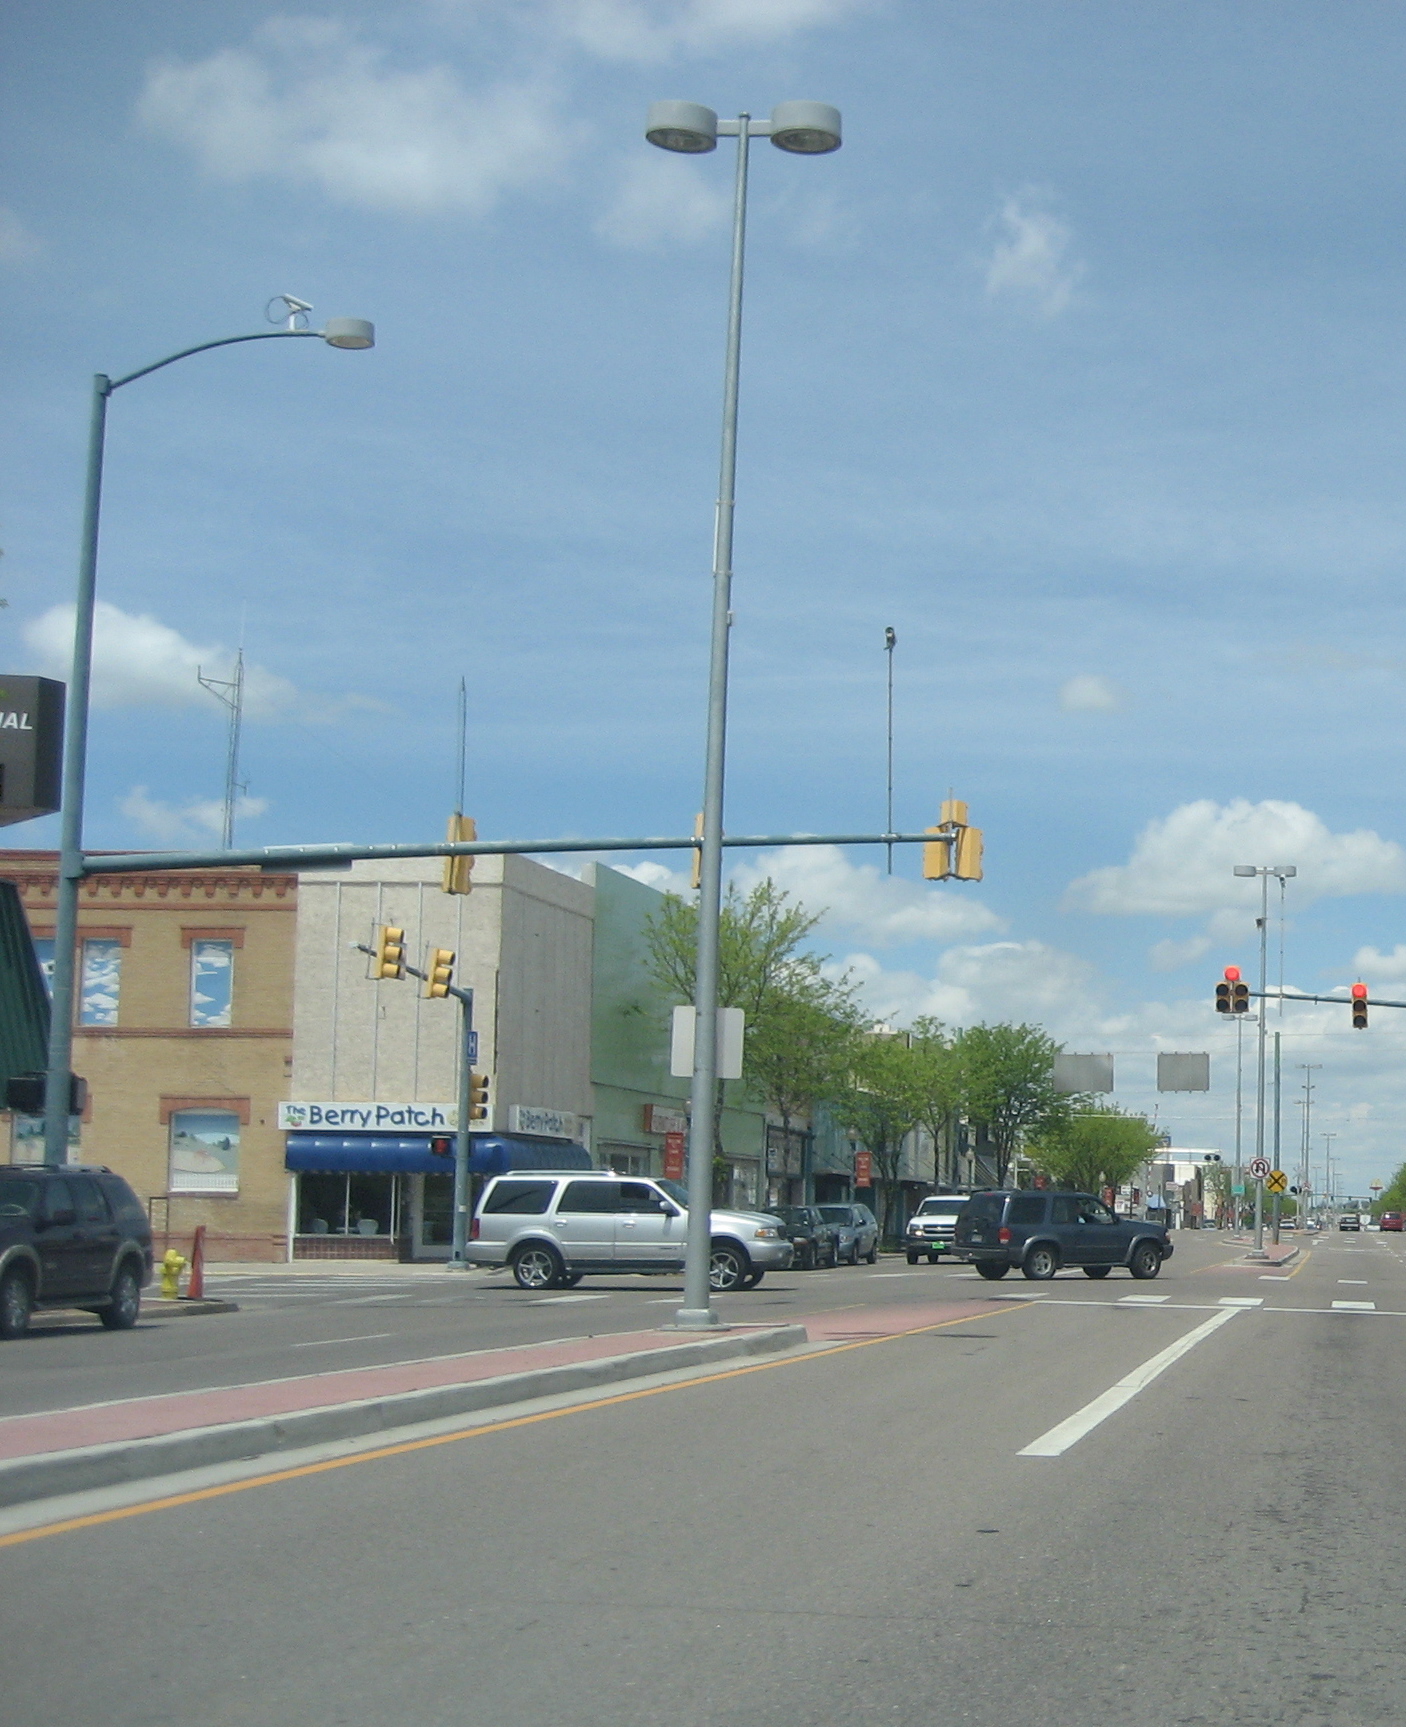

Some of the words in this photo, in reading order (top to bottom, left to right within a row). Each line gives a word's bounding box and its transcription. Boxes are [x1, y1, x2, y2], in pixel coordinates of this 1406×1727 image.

[286, 1105, 306, 1116] The
[309, 1105, 371, 1127] Berry
[375, 1105, 445, 1127] Patch
